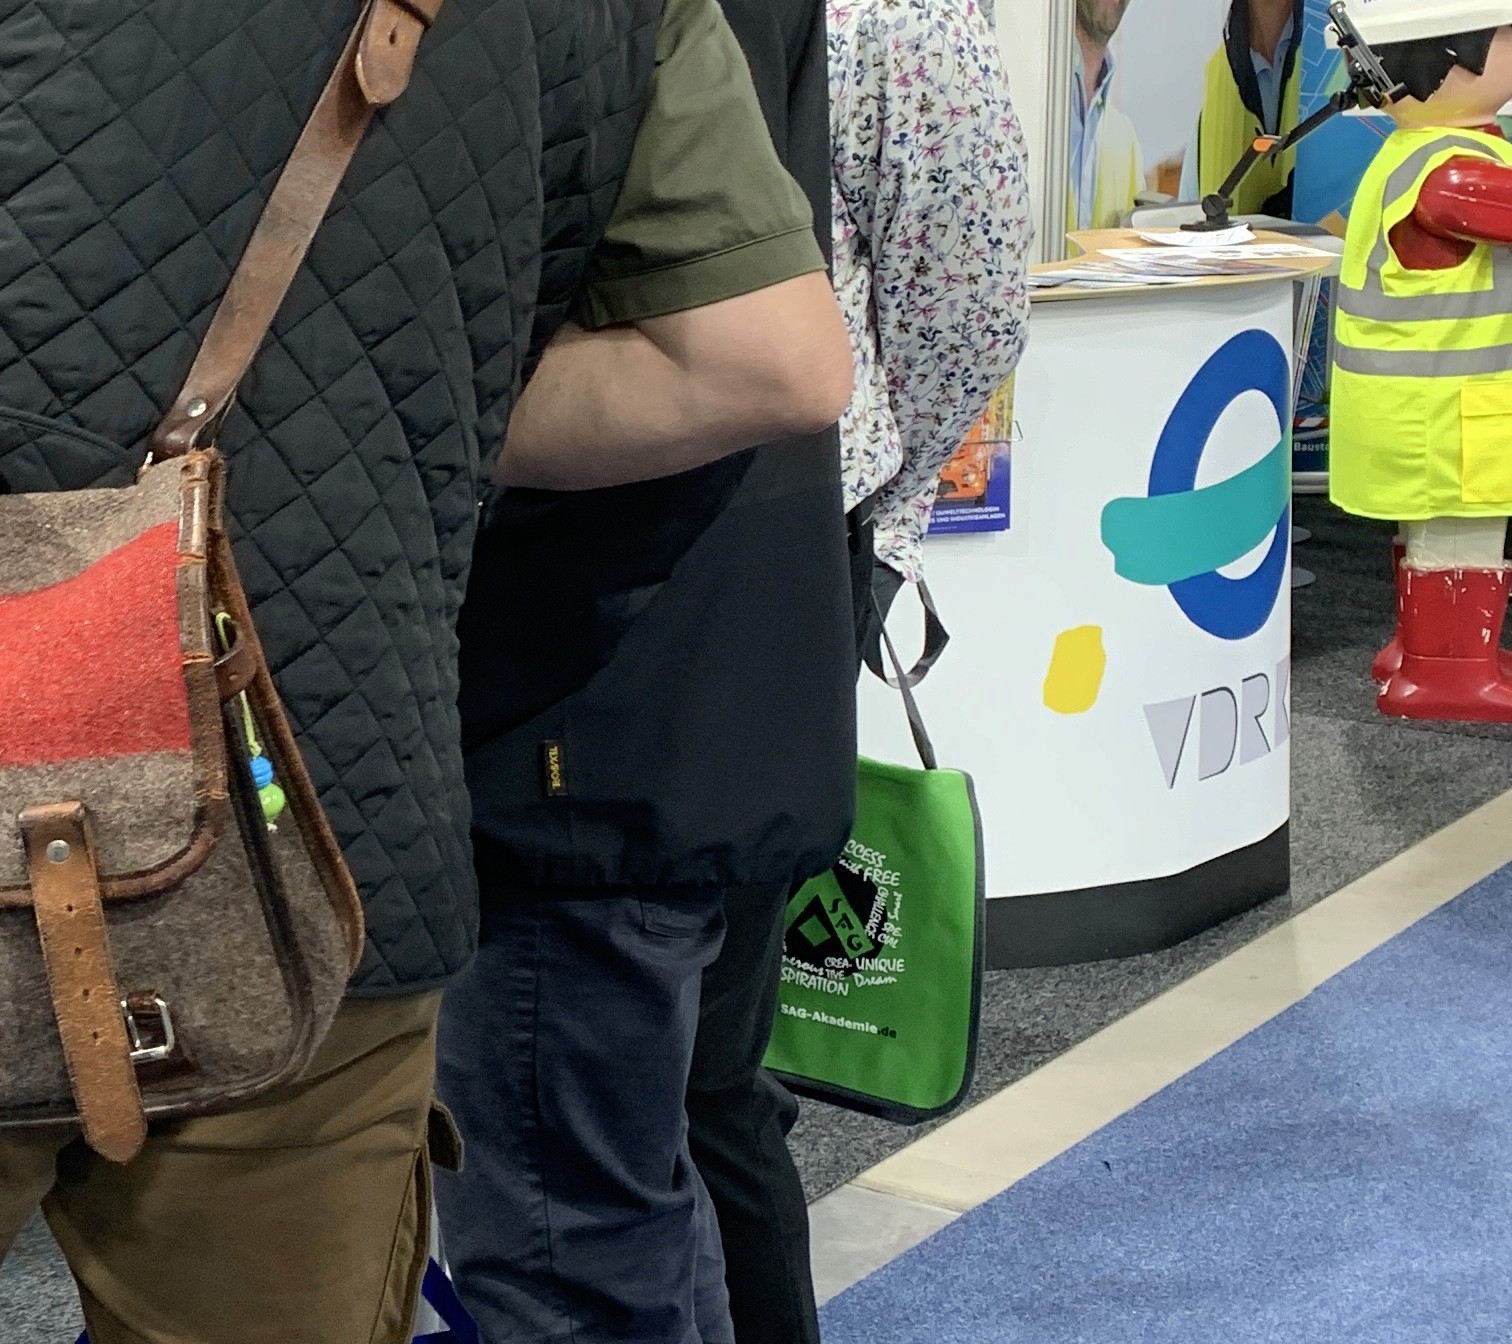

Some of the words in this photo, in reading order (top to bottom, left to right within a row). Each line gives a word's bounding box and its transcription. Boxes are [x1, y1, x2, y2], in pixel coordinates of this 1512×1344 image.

[863, 866, 901, 886] FREE
[855, 957, 905, 973] UNIQUE
[852, 972, 898, 988] Dream
